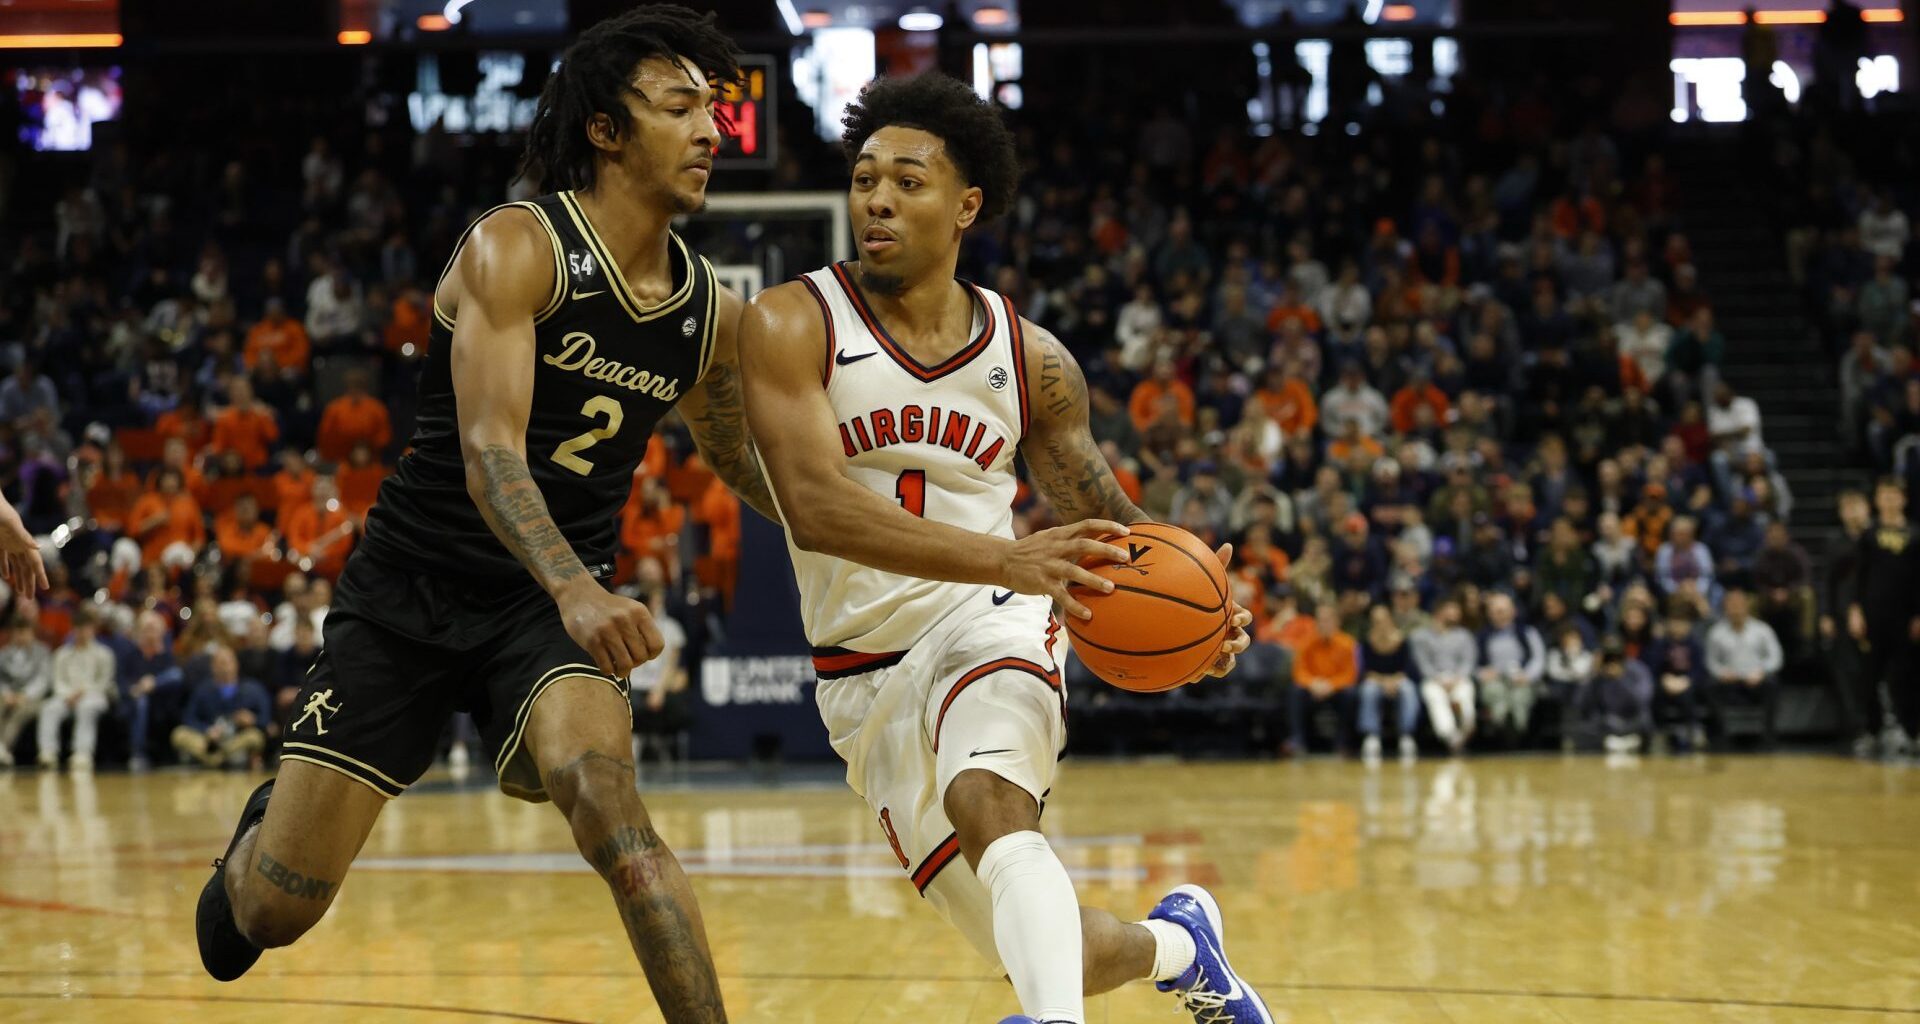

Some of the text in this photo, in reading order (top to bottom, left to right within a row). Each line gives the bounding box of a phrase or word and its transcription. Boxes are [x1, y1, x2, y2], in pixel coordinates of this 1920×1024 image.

[569, 252, 593, 276] 54
[543, 331, 679, 402] Deacons
[550, 395, 624, 477] 2
[896, 469, 926, 518] 1
[1128, 543, 1153, 564] V
[257, 852, 337, 900] EBONY
